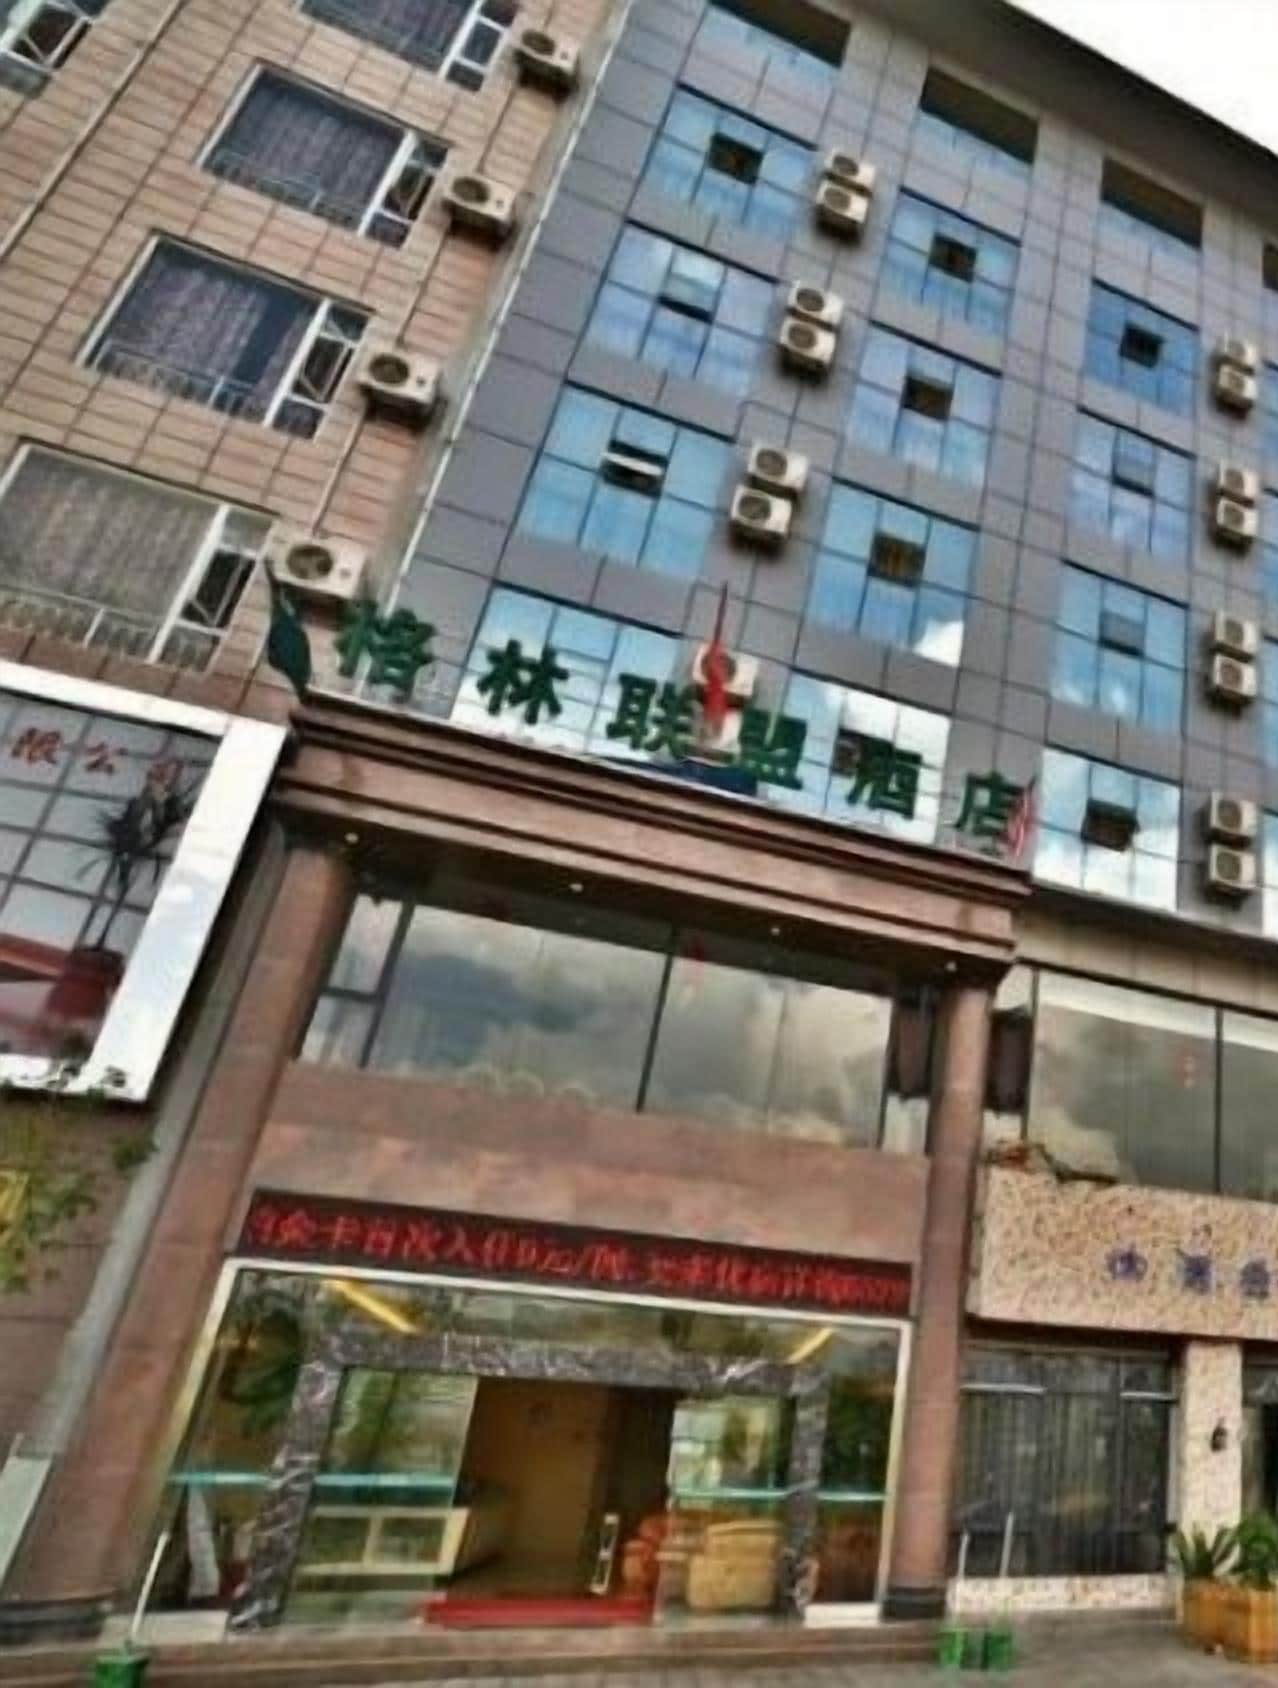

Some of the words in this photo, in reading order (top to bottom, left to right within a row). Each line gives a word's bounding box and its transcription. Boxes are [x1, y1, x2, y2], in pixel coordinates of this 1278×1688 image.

[334, 600, 1030, 840] 格林联盟酒店
